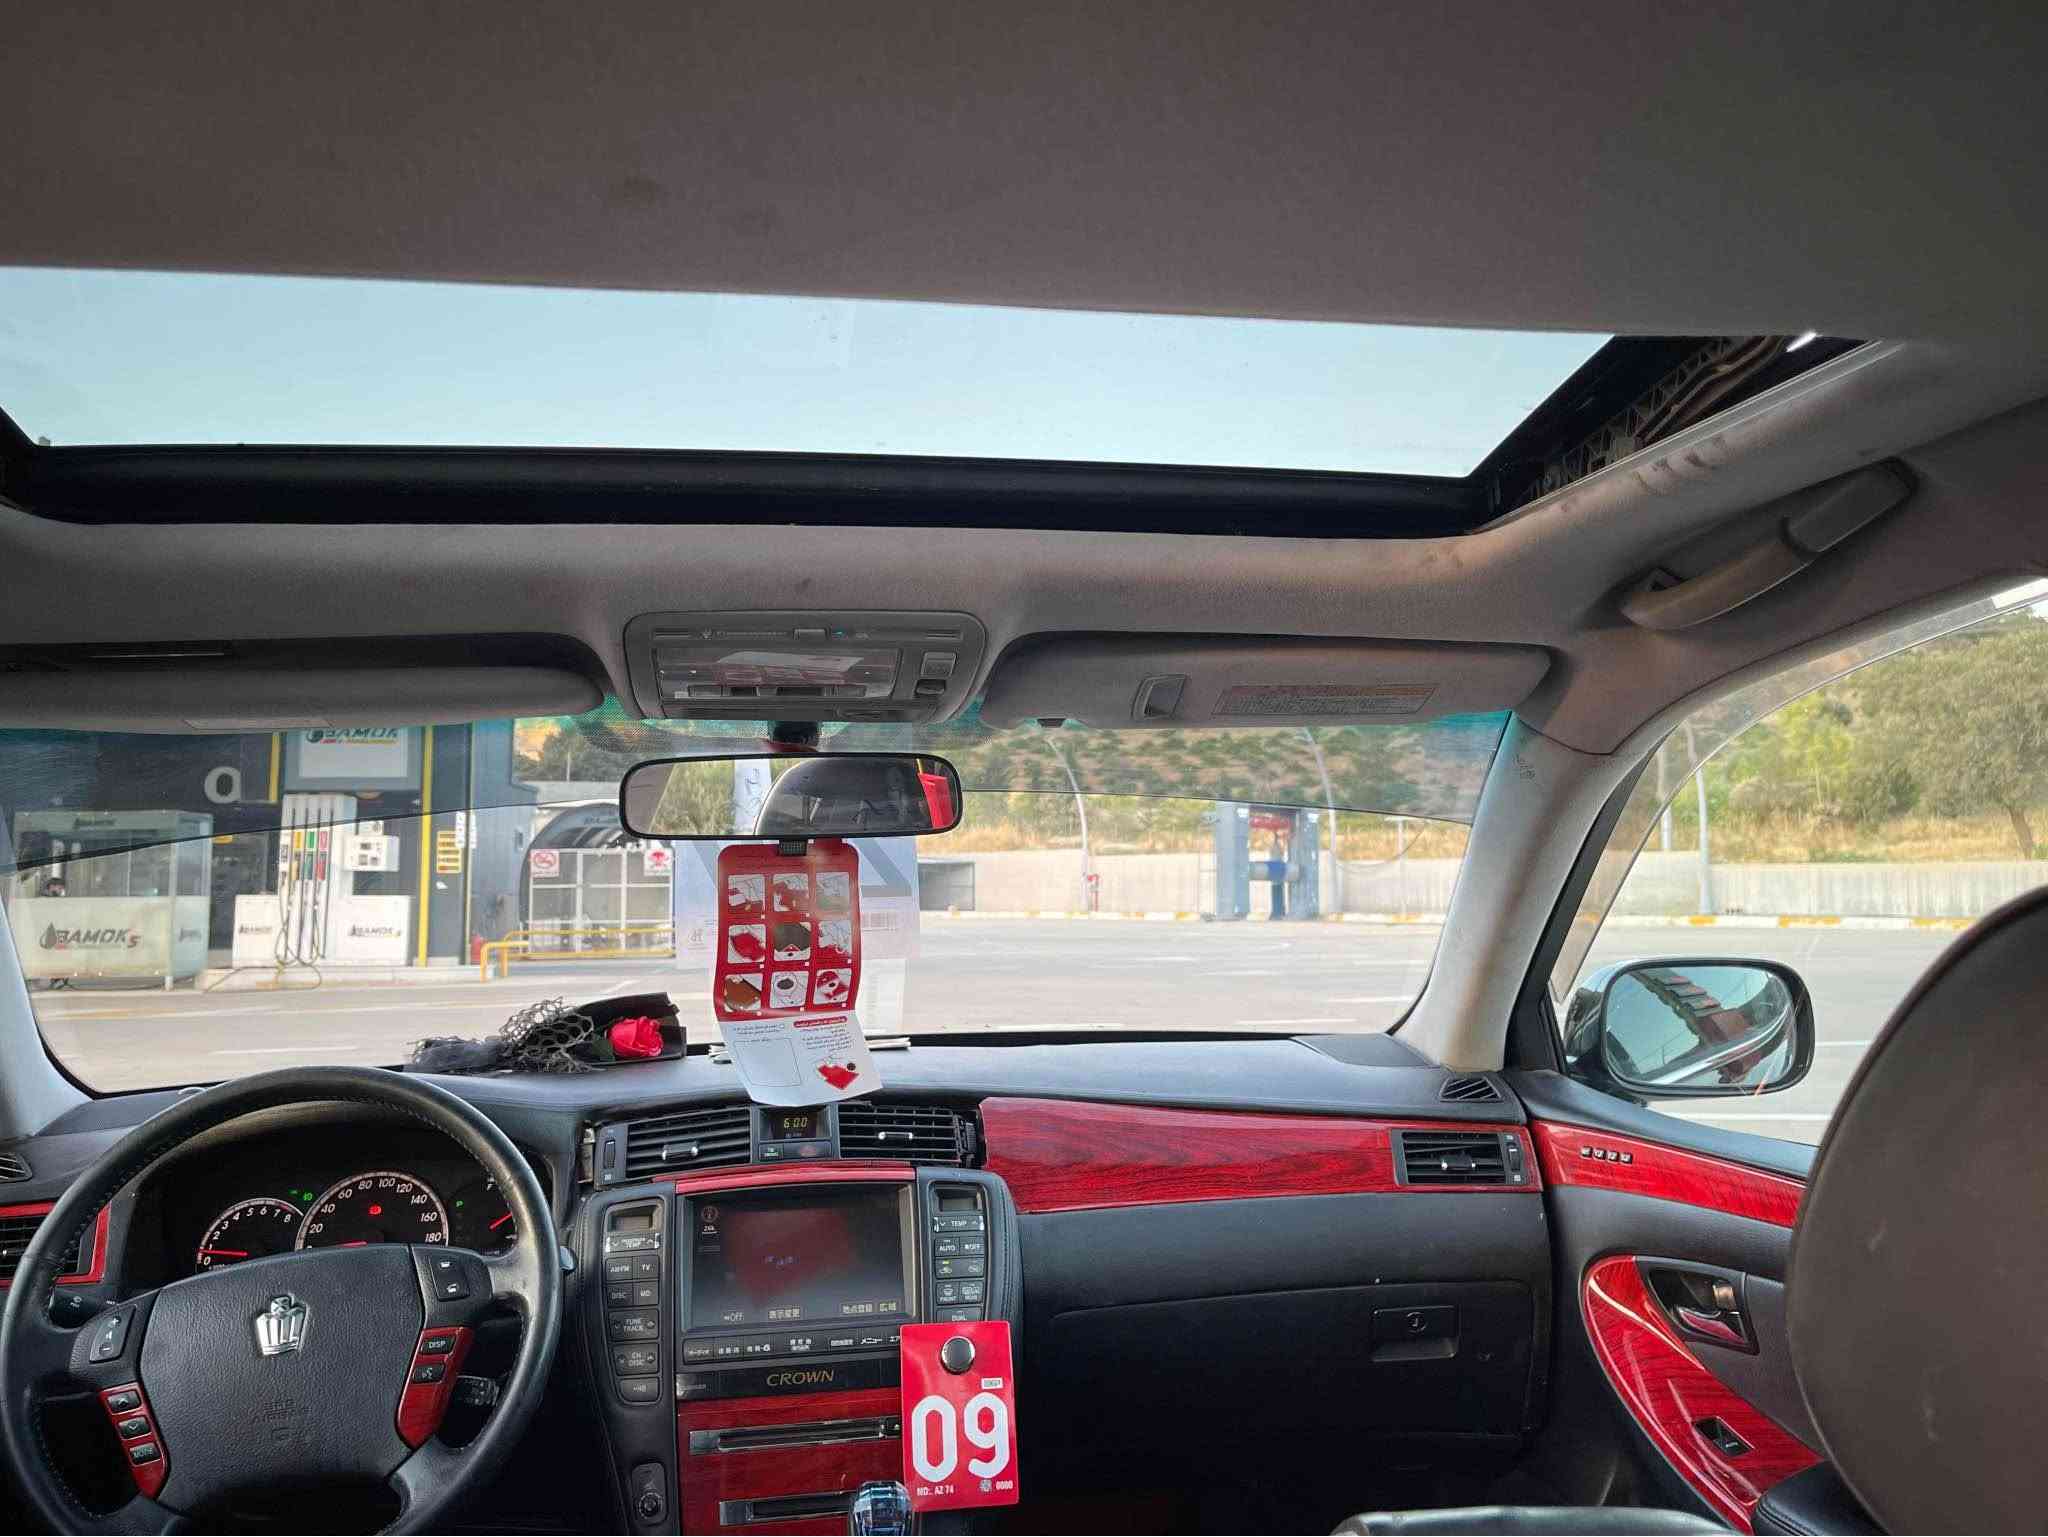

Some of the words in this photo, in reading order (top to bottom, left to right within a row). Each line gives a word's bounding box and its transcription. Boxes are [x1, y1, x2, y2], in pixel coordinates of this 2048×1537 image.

[358, 1180, 373, 1190] 80
[378, 1178, 396, 1188] 100
[396, 1183, 413, 1194] 120
[338, 1189, 353, 1199] 60
[411, 1193, 428, 1205] 140
[246, 1208, 254, 1217] 5
[260, 1207, 268, 1216] 6
[273, 1209, 281, 1218] 7
[321, 1203, 336, 1214] 40
[232, 1212, 240, 1221] 4
[284, 1214, 292, 1223] 8
[420, 1212, 438, 1223] 160
[221, 1221, 229, 1230] 3
[309, 1223, 324, 1234] 20
[213, 1231, 221, 1240] 2
[424, 1231, 442, 1243] 180
[203, 1256, 211, 1266] 0
[427, 1340, 446, 1349] DISP
[766, 1369, 834, 1387] CROWN
[911, 1391, 1010, 1483] 09
